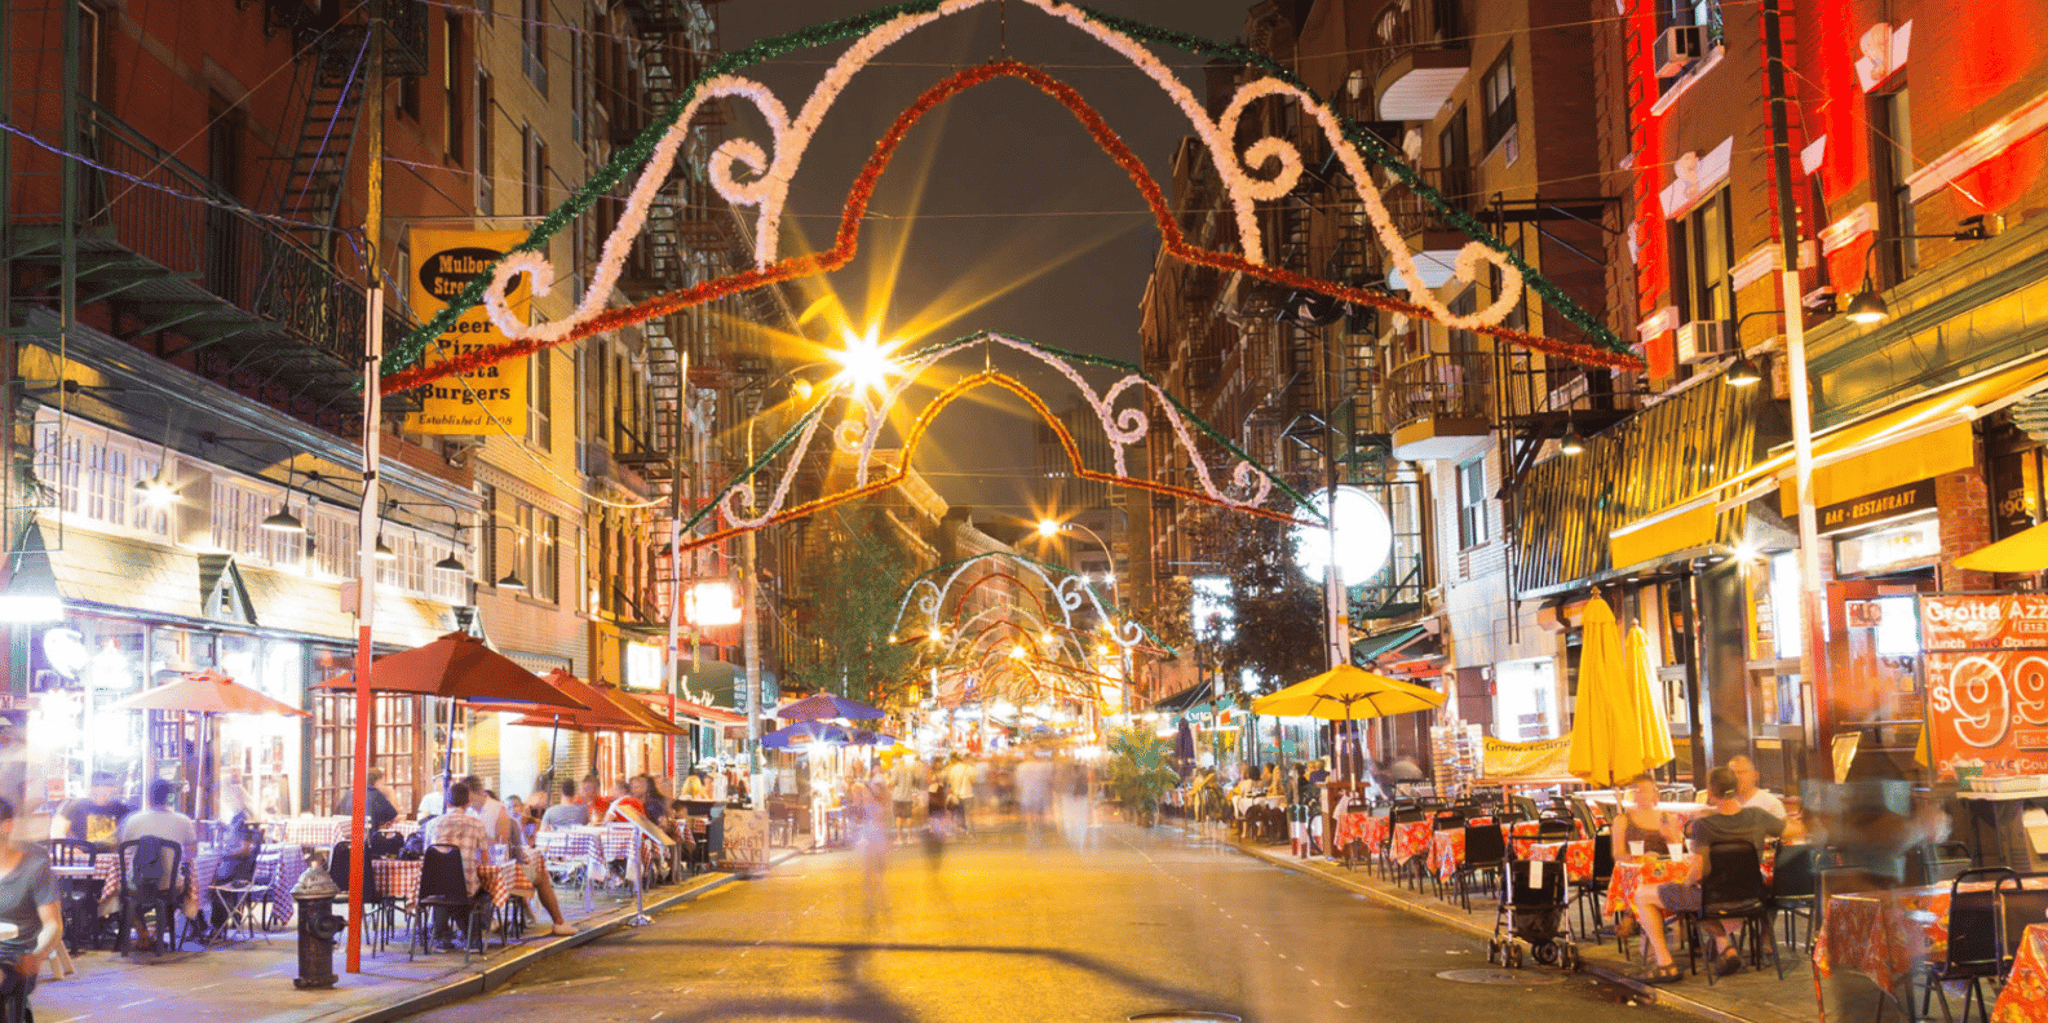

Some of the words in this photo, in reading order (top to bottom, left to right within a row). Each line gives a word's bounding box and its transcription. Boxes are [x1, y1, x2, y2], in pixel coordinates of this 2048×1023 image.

[438, 255, 492, 274] Mulber
[434, 276, 470, 295] Stre
[437, 338, 496, 357] Pizz
[422, 382, 511, 405] Burgers
[418, 414, 482, 426] Established
[1824, 508, 1844, 526] BAR
[1852, 489, 1917, 520] RESTAURANT
[1927, 600, 2001, 621] Grotta
[1927, 637, 1967, 649] Lunch
